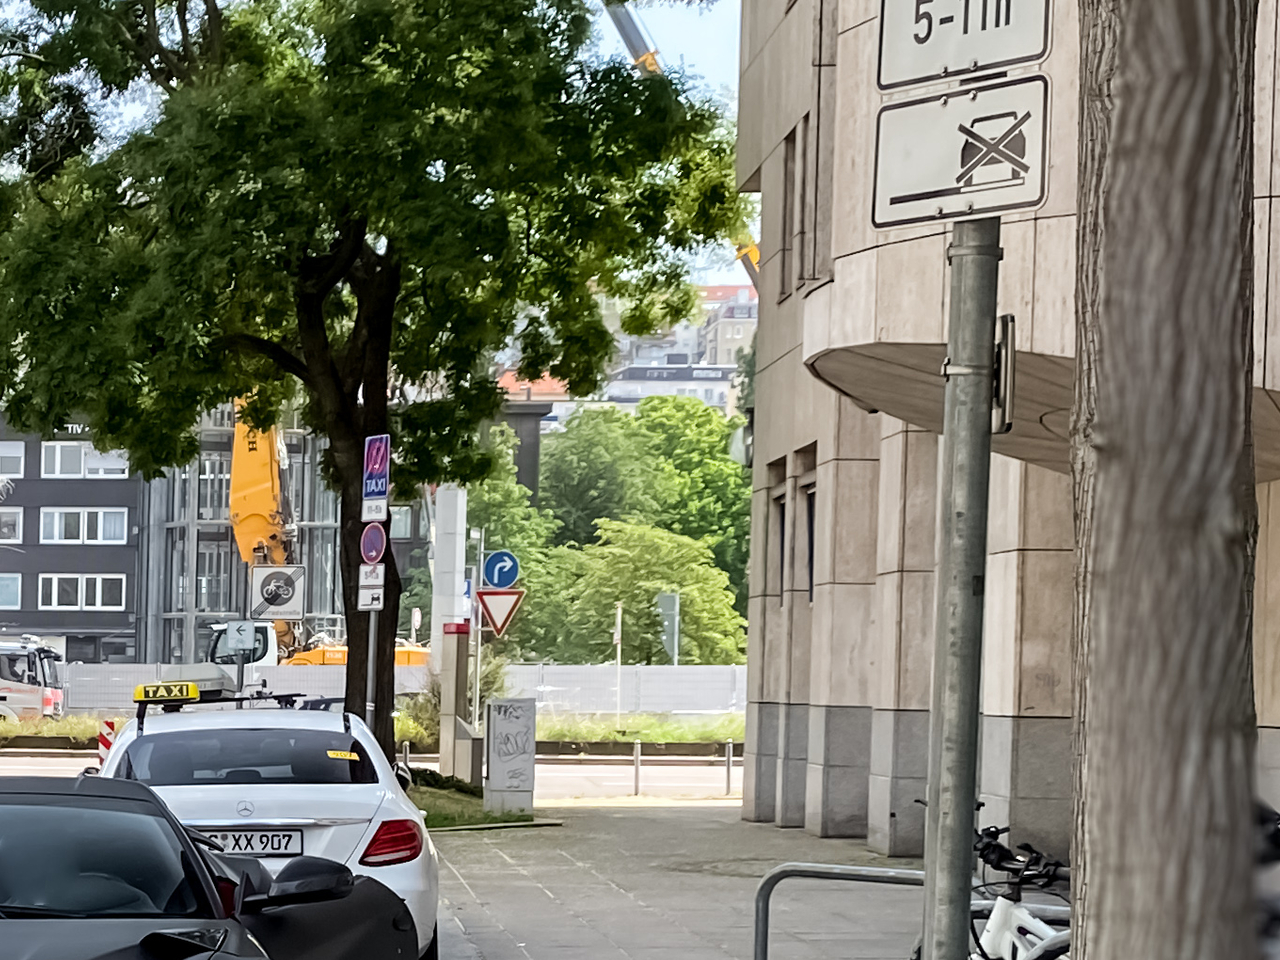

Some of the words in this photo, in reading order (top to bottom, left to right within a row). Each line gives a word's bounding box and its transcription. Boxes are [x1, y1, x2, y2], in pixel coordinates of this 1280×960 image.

[366, 478, 386, 492] TAXI
[145, 685, 188, 698] TAXI
[231, 834, 254, 851] XX
[259, 834, 293, 851] 907
